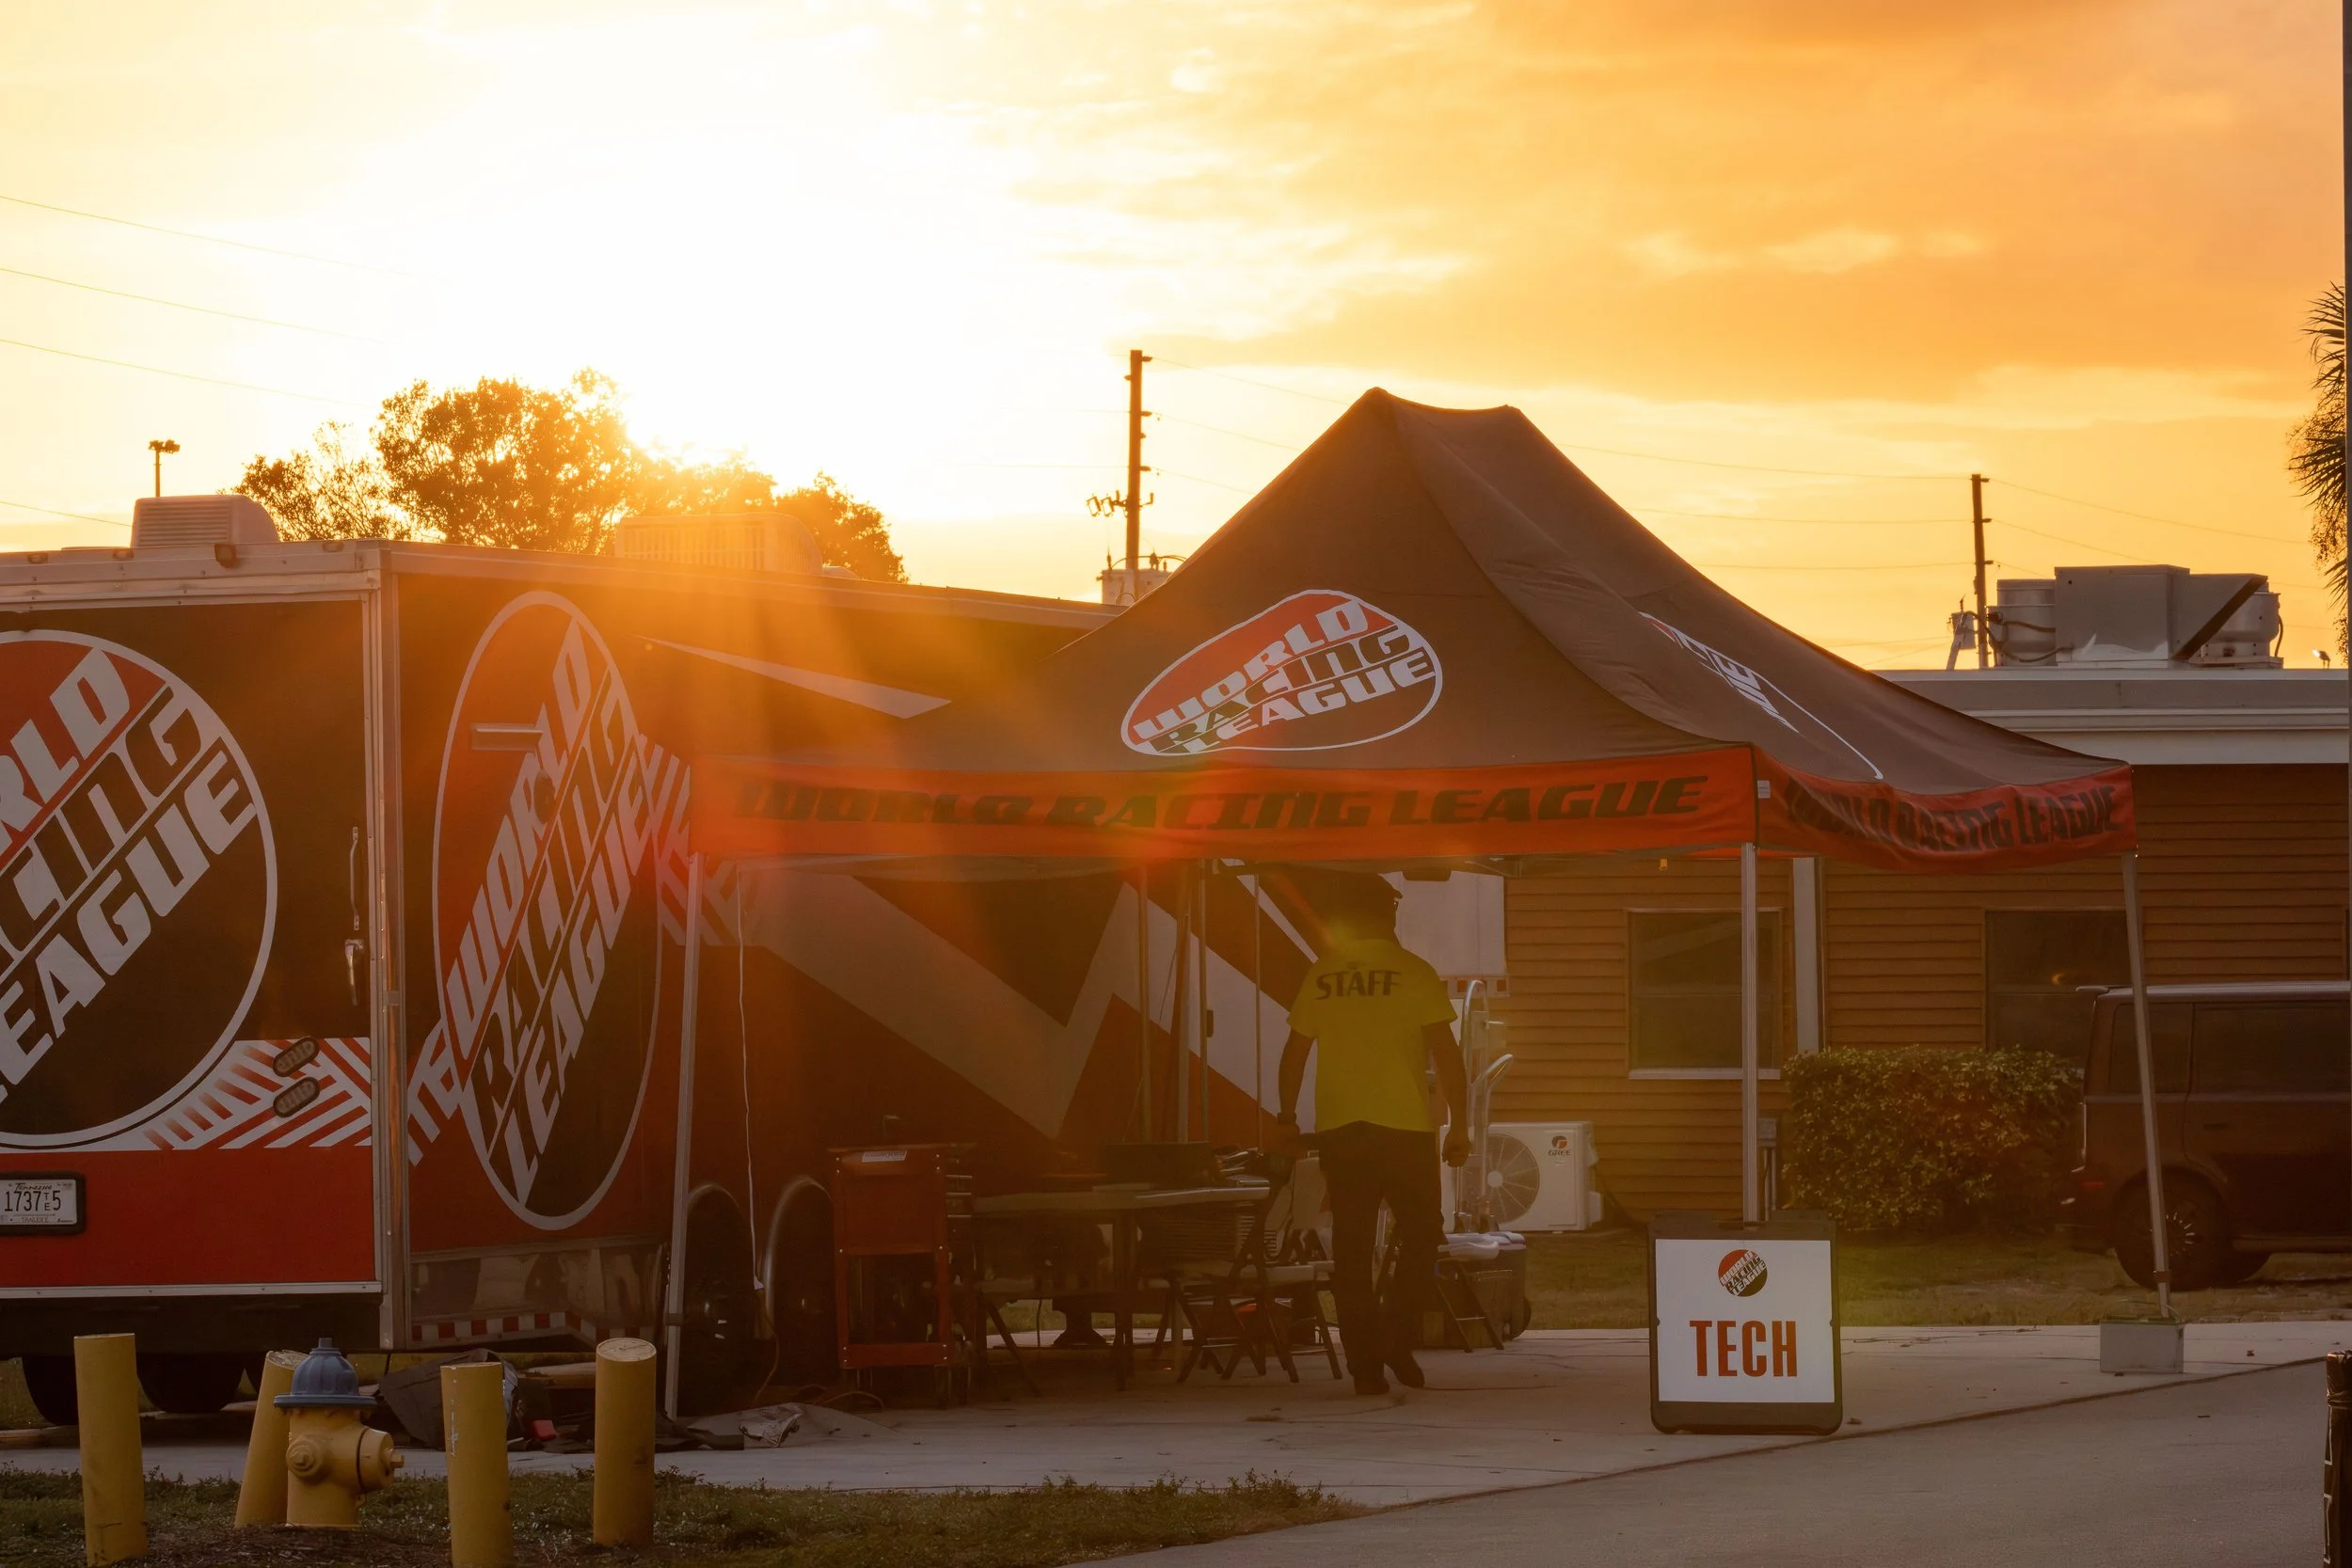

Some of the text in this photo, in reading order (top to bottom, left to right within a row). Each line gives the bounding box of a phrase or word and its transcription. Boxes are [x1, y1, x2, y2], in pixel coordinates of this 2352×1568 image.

[1133, 602, 1369, 743] WORLD
[1148, 625, 1410, 752] RACING
[1183, 650, 1437, 753] LEAGUE
[0, 646, 131, 847] RLD
[0, 686, 201, 974] CING
[446, 617, 591, 1060] WORLD
[735, 775, 1708, 831] WORLD RACING LEAGUE
[2016, 785, 2122, 846] LEAGUE
[0, 749, 257, 1106] EAGUE
[504, 750, 652, 1207] LEAGUE
[1315, 969, 1402, 1000] STAFF
[1720, 1250, 1754, 1286] WORLD
[1725, 1256, 1761, 1292] RACING
[1732, 1259, 1767, 1296] LEAGUE
[1690, 1320, 1798, 1377] TECH
